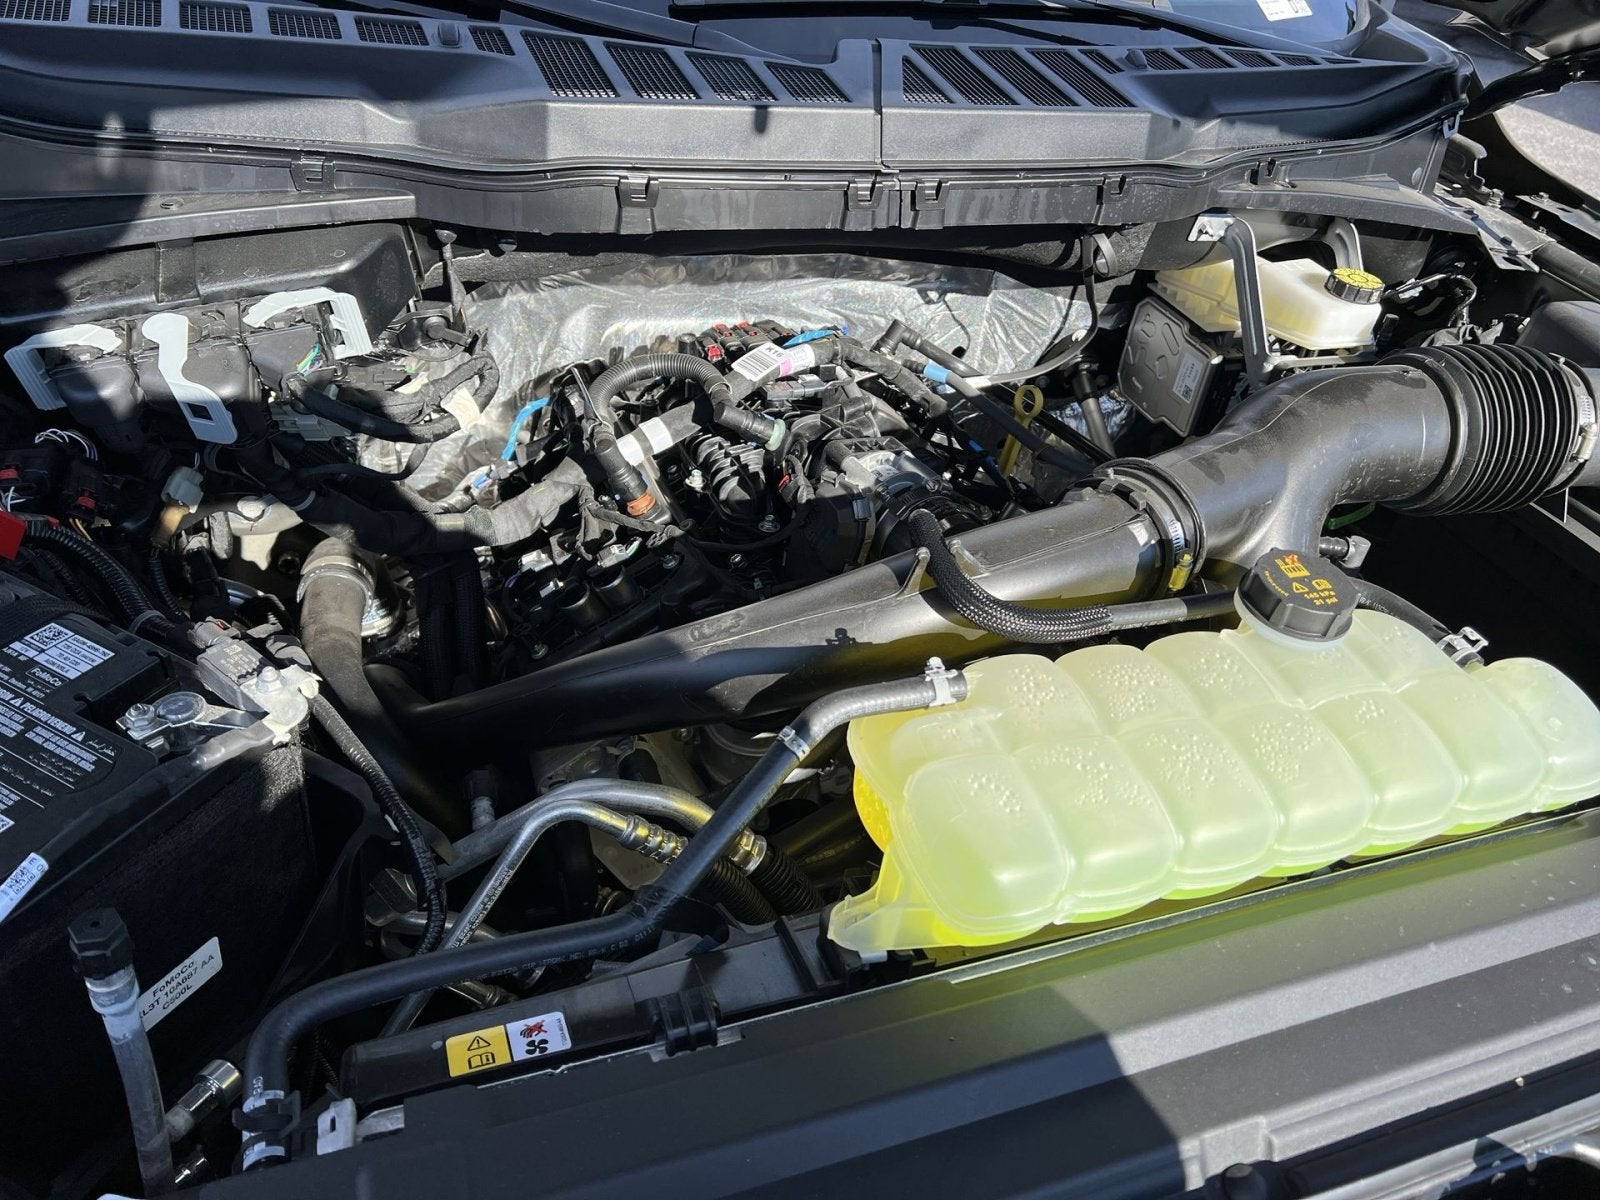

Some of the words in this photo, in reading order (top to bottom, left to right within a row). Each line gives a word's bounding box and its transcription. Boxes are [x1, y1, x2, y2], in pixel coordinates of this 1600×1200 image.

[765, 346, 782, 358] K16
[31, 667, 62, 687] FoMoCo
[141, 996, 161, 1019] L3T
[201, 954, 215, 969] AA
[152, 960, 195, 998] FoMoCo
[162, 984, 193, 1010] C500L
